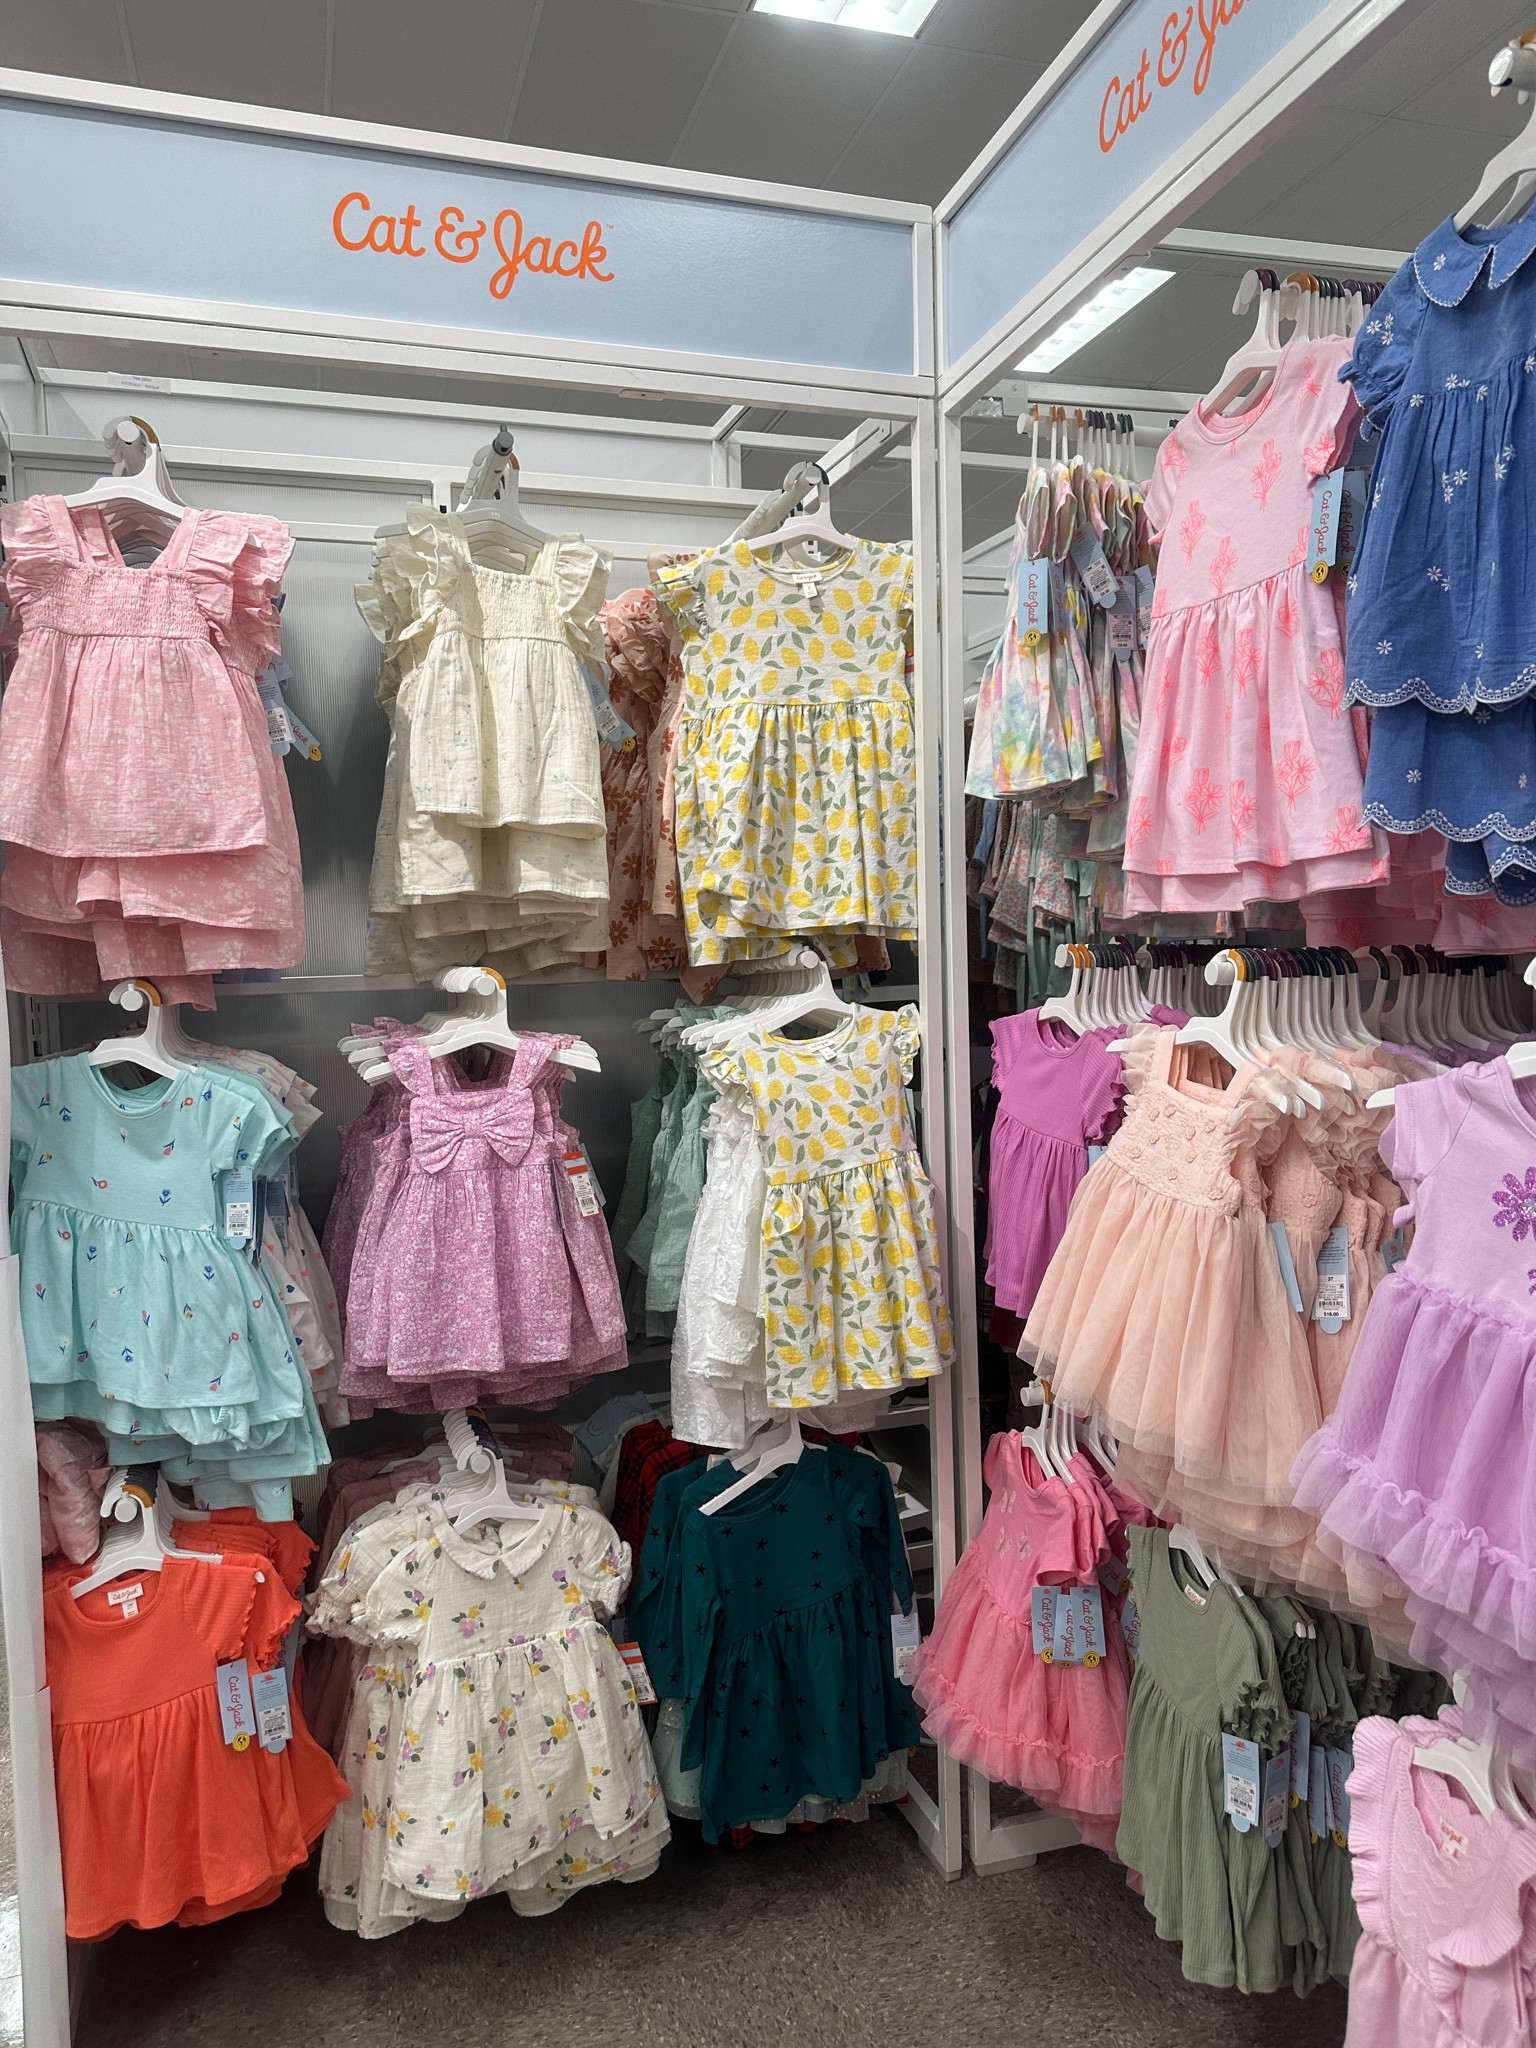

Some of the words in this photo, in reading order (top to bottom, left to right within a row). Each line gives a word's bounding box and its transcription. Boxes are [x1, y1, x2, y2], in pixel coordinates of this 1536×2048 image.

[1099, 48, 1152, 153] Cat
[1158, 6, 1193, 87] &
[333, 192, 426, 257] Cat
[434, 206, 487, 263] &
[489, 209, 615, 299] Jack
[1322, 490, 1332, 513] Cat
[1320, 513, 1330, 525] &
[1314, 525, 1328, 557] Jack
[1028, 573, 1039, 590] Cat
[1028, 590, 1039, 600] &
[1023, 600, 1038, 625] Jack
[1041, 1597, 1052, 1612] Cat
[1082, 1599, 1093, 1615] Cat
[1042, 1612, 1052, 1621] &
[1083, 1615, 1093, 1626] &
[1038, 1621, 1053, 1643] Jack
[1080, 1625, 1097, 1648] Jack
[228, 1676, 239, 1694] Cat
[231, 1694, 241, 1703] &
[227, 1703, 246, 1729] Jack
